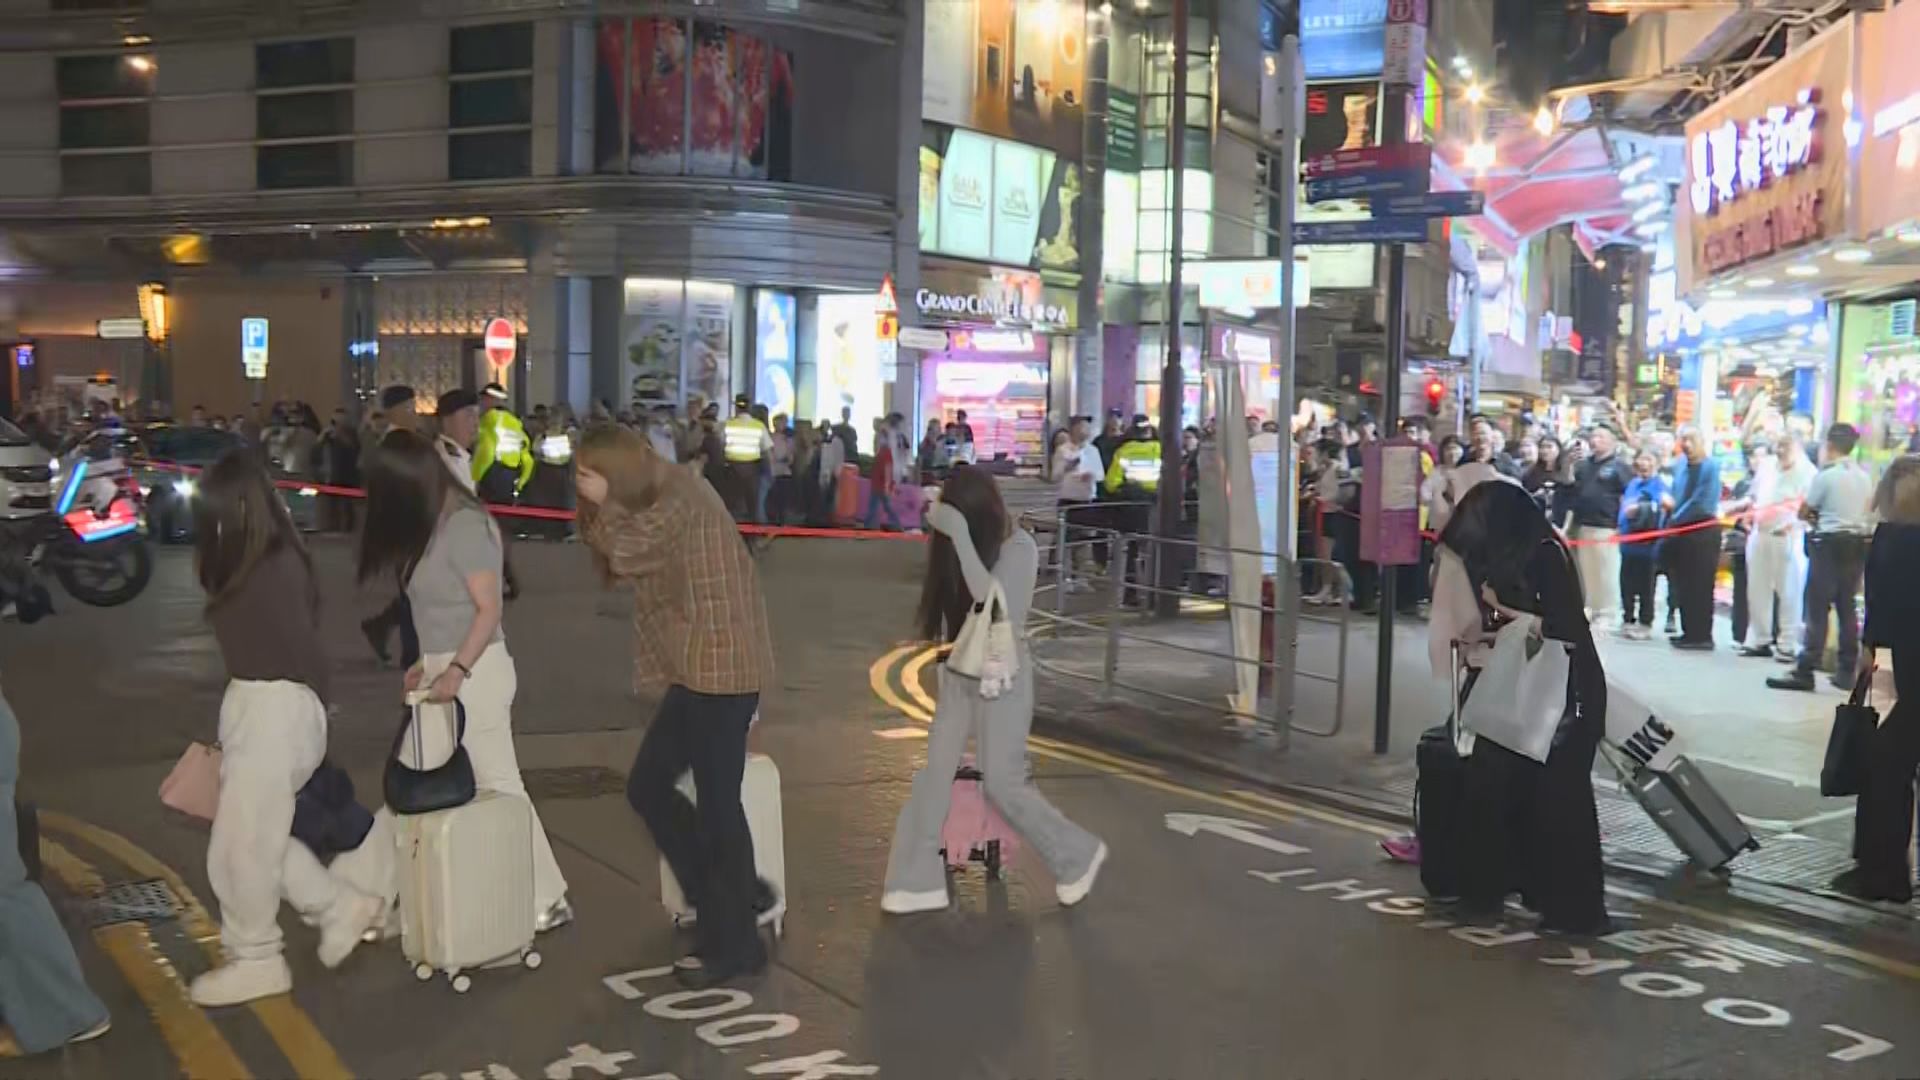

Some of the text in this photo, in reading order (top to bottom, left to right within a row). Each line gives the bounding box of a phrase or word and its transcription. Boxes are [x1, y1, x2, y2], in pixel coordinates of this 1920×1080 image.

[248, 322, 263, 347] P
[602, 964, 881, 1080] LOOK
[1539, 946, 1897, 1063] LOOK
